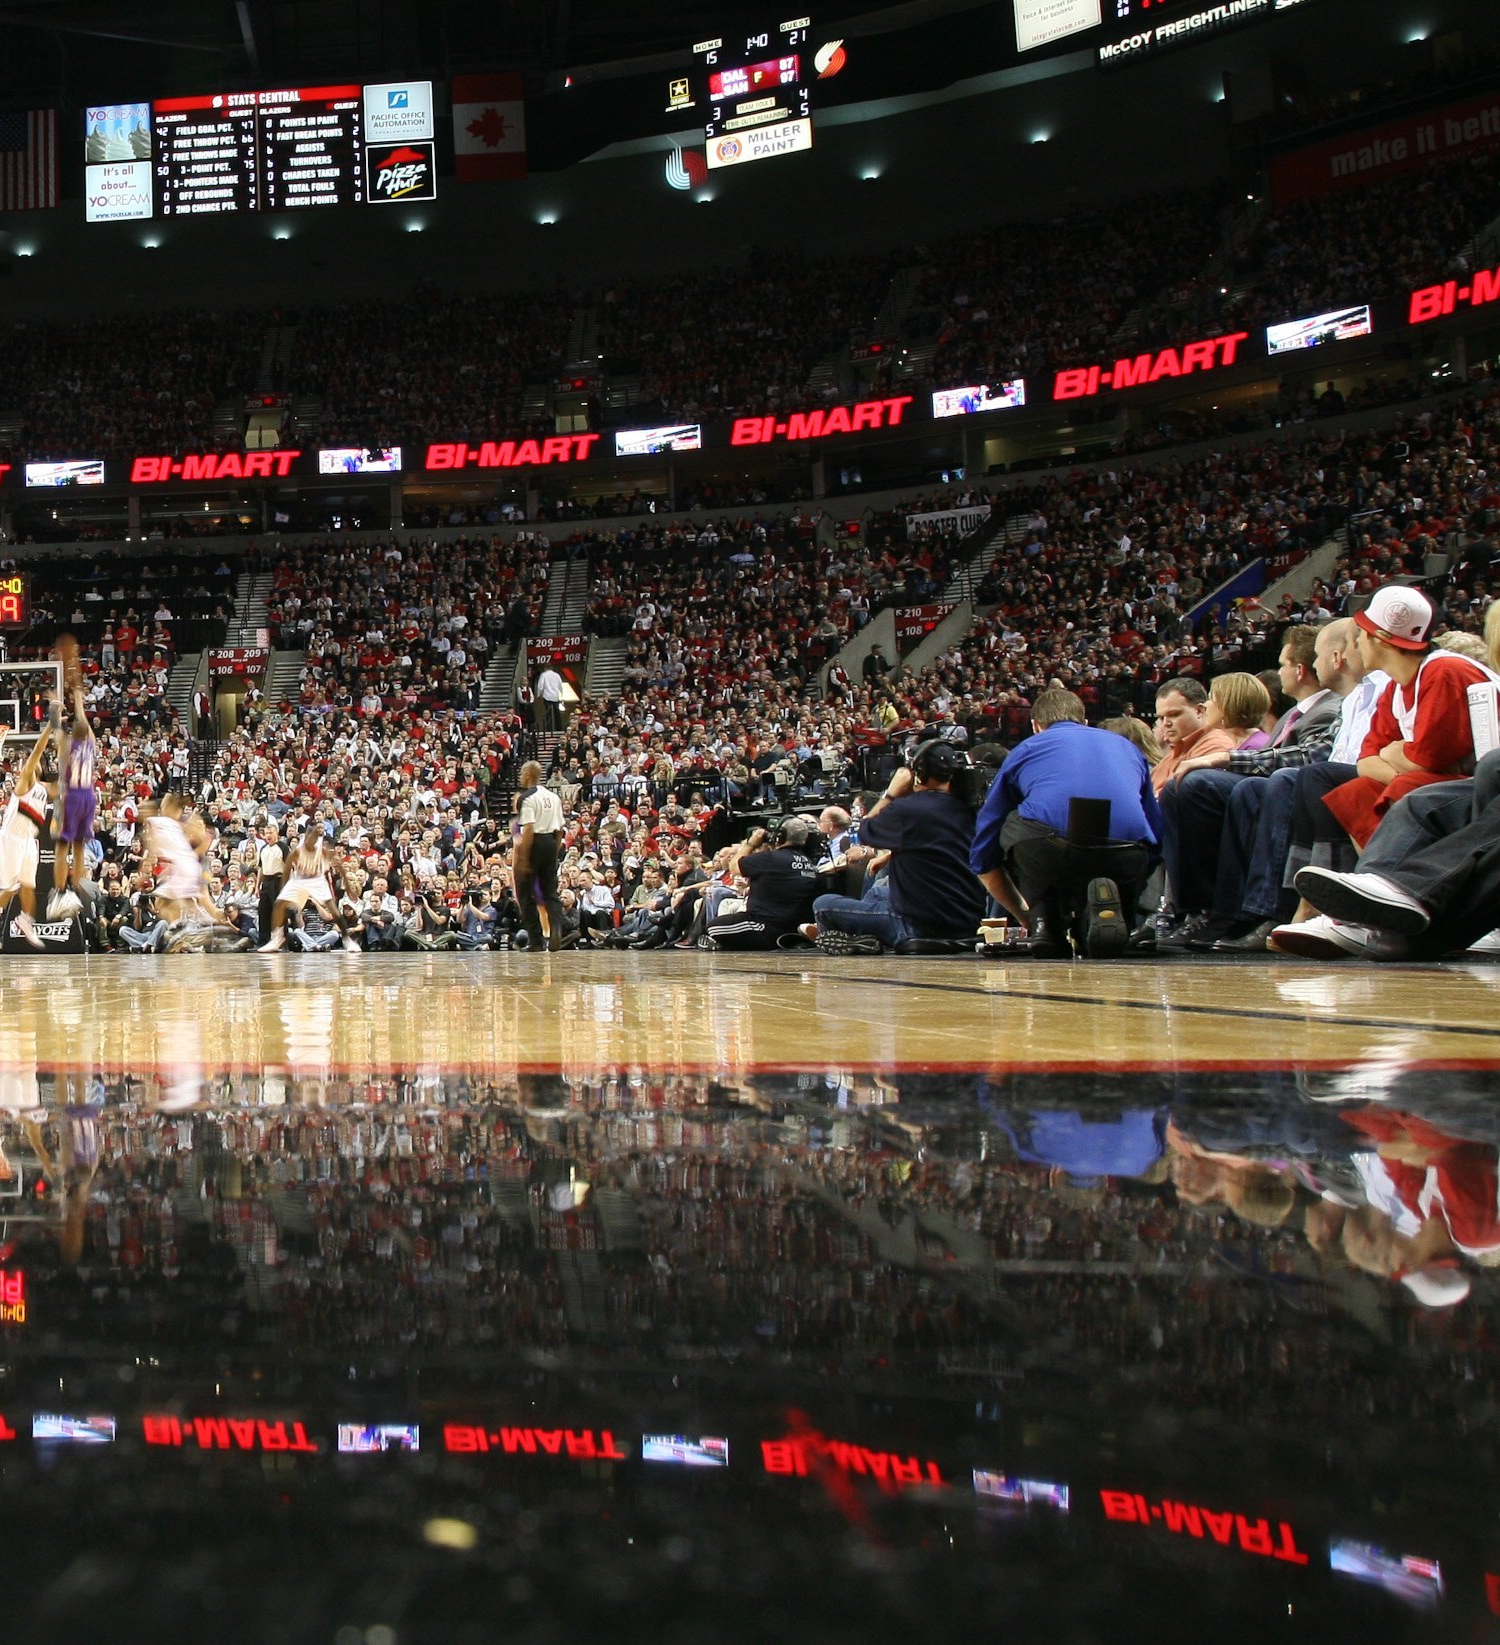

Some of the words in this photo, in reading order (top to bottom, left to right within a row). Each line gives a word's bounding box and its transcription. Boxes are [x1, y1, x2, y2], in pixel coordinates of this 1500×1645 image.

[781, 19, 809, 30] GUEST
[747, 33, 768, 49] 1:40
[790, 30, 806, 45] 21
[695, 40, 720, 51] HOME
[1100, 31, 1152, 59] McCOY
[707, 51, 717, 64] 15
[721, 69, 748, 83] DAL
[754, 71, 762, 83] F
[228, 94, 255, 106] STATS
[260, 91, 300, 103] CENTRAL
[713, 107, 720, 120] 3
[799, 88, 808, 99] 4
[260, 107, 291, 115] BLAZERS
[334, 102, 358, 110] GUEST
[801, 103, 808, 116] 5
[156, 115, 187, 123] BLAZERS
[280, 118, 306, 127] POINTS
[317, 115, 338, 125] PAINT
[374, 119, 424, 128] AUTOMATION
[157, 127, 168, 136] 42
[176, 126, 196, 135] FIELD
[198, 125, 216, 134] GOAL
[217, 123, 233, 132] PCT.
[242, 121, 253, 129] 47
[277, 132, 293, 140] FAST
[294, 130, 317, 140] BREAK
[318, 128, 343, 137] POINTS
[706, 124, 714, 136] 5
[748, 124, 800, 144] MILLER
[174, 139, 192, 148] FREE
[193, 137, 219, 147] THROW
[220, 136, 236, 145] PCT.
[295, 143, 325, 153] ASSISTS
[754, 139, 795, 155] PAINT
[173, 152, 190, 161] FREE
[191, 150, 218, 160] THROWS
[219, 149, 238, 158] MADE
[1331, 138, 1407, 177] make
[1417, 125, 1436, 154] it
[290, 155, 332, 166] TURNOVERS
[104, 168, 118, 176] It's
[122, 166, 134, 175] all
[157, 167, 169, 175] 50
[215, 163, 231, 171] PCT.
[282, 170, 316, 180] CHARGES
[317, 168, 340, 177] TAKEN
[219, 175, 239, 184] MADE
[377, 163, 427, 189] Pizza
[288, 183, 310, 193] TOTAL
[311, 182, 335, 191] FOULS
[386, 174, 422, 194] Hut
[179, 192, 193, 200] OFF
[195, 189, 233, 199] REBOUNDS
[285, 197, 310, 206] BENCH
[312, 195, 338, 205] POINTS
[176, 205, 190, 214] 2ND
[222, 202, 238, 210] PTS.
[1053, 331, 1248, 401] BI-MART
[730, 395, 913, 446] BI-MART
[425, 433, 600, 470] BI-MART
[130, 450, 301, 483] BI-MART
[1274, 555, 1290, 566] 211
[904, 608, 921, 617] 210
[905, 626, 922, 635] 108
[536, 639, 553, 648] 209
[564, 637, 580, 646] 210
[217, 650, 234, 658] 208
[244, 650, 261, 658] 209
[536, 655, 551, 664] 107
[565, 654, 580, 662] 108
[217, 666, 233, 674] 106
[246, 665, 261, 673] 107
[543, 797, 551, 808] 33
